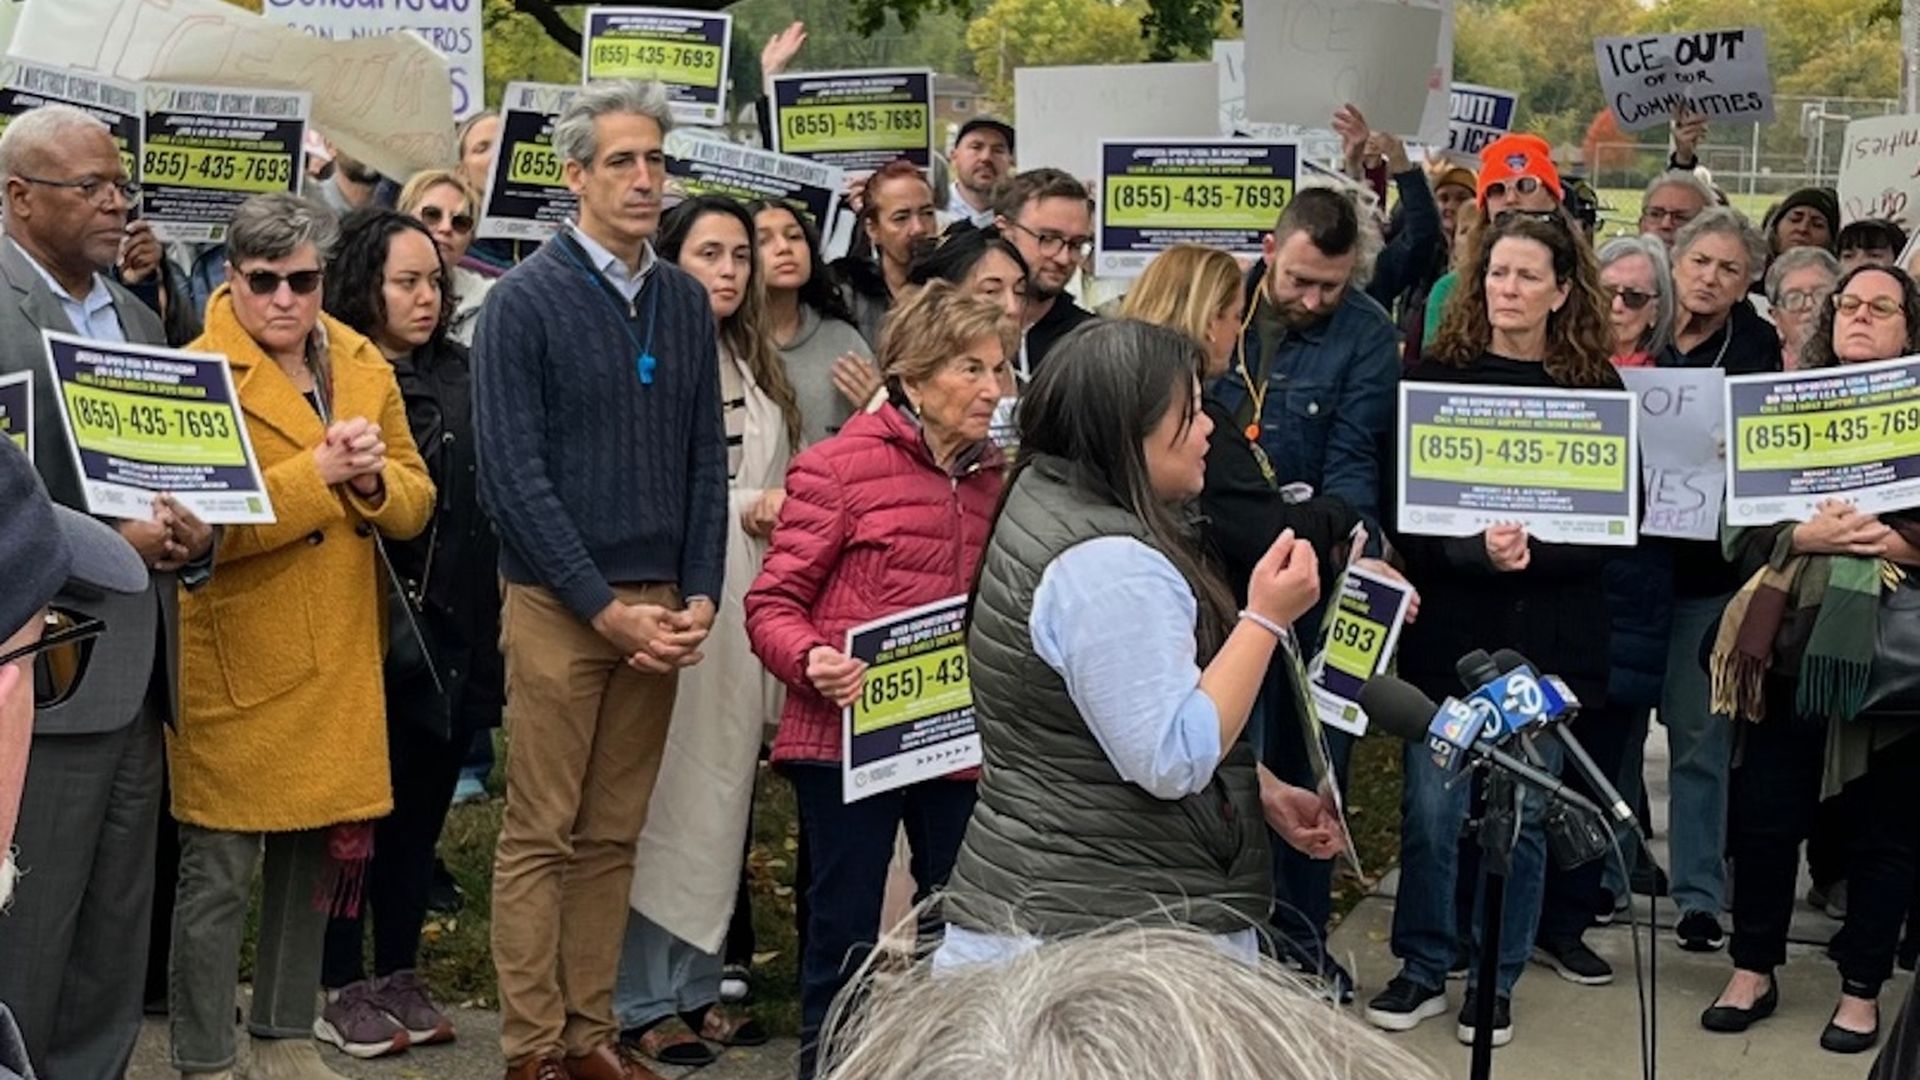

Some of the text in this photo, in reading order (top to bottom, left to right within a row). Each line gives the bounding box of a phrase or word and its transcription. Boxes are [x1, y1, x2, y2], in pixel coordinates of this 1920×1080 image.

[594, 45, 716, 69] (855)-435-7693
[1606, 30, 1744, 76] ICE OUT
[1644, 70, 1714, 86] OF OUR
[787, 109, 923, 138] (855)-435-7693
[1462, 128, 1500, 154] ICE
[143, 151, 290, 183] 855)-435-7693
[512, 149, 563, 181] (855)
[1114, 184, 1285, 212] (855)-435-7693
[72, 396, 230, 438] (855)-435-7693
[1642, 386, 1698, 417] OF
[1745, 407, 1920, 454] (855)-435-769
[1419, 434, 1618, 466] (855)-435-7693
[1644, 465, 1706, 514] IES
[1334, 618, 1376, 653] 693
[862, 655, 967, 713] (855)-43
[1430, 736, 1451, 756] 5
